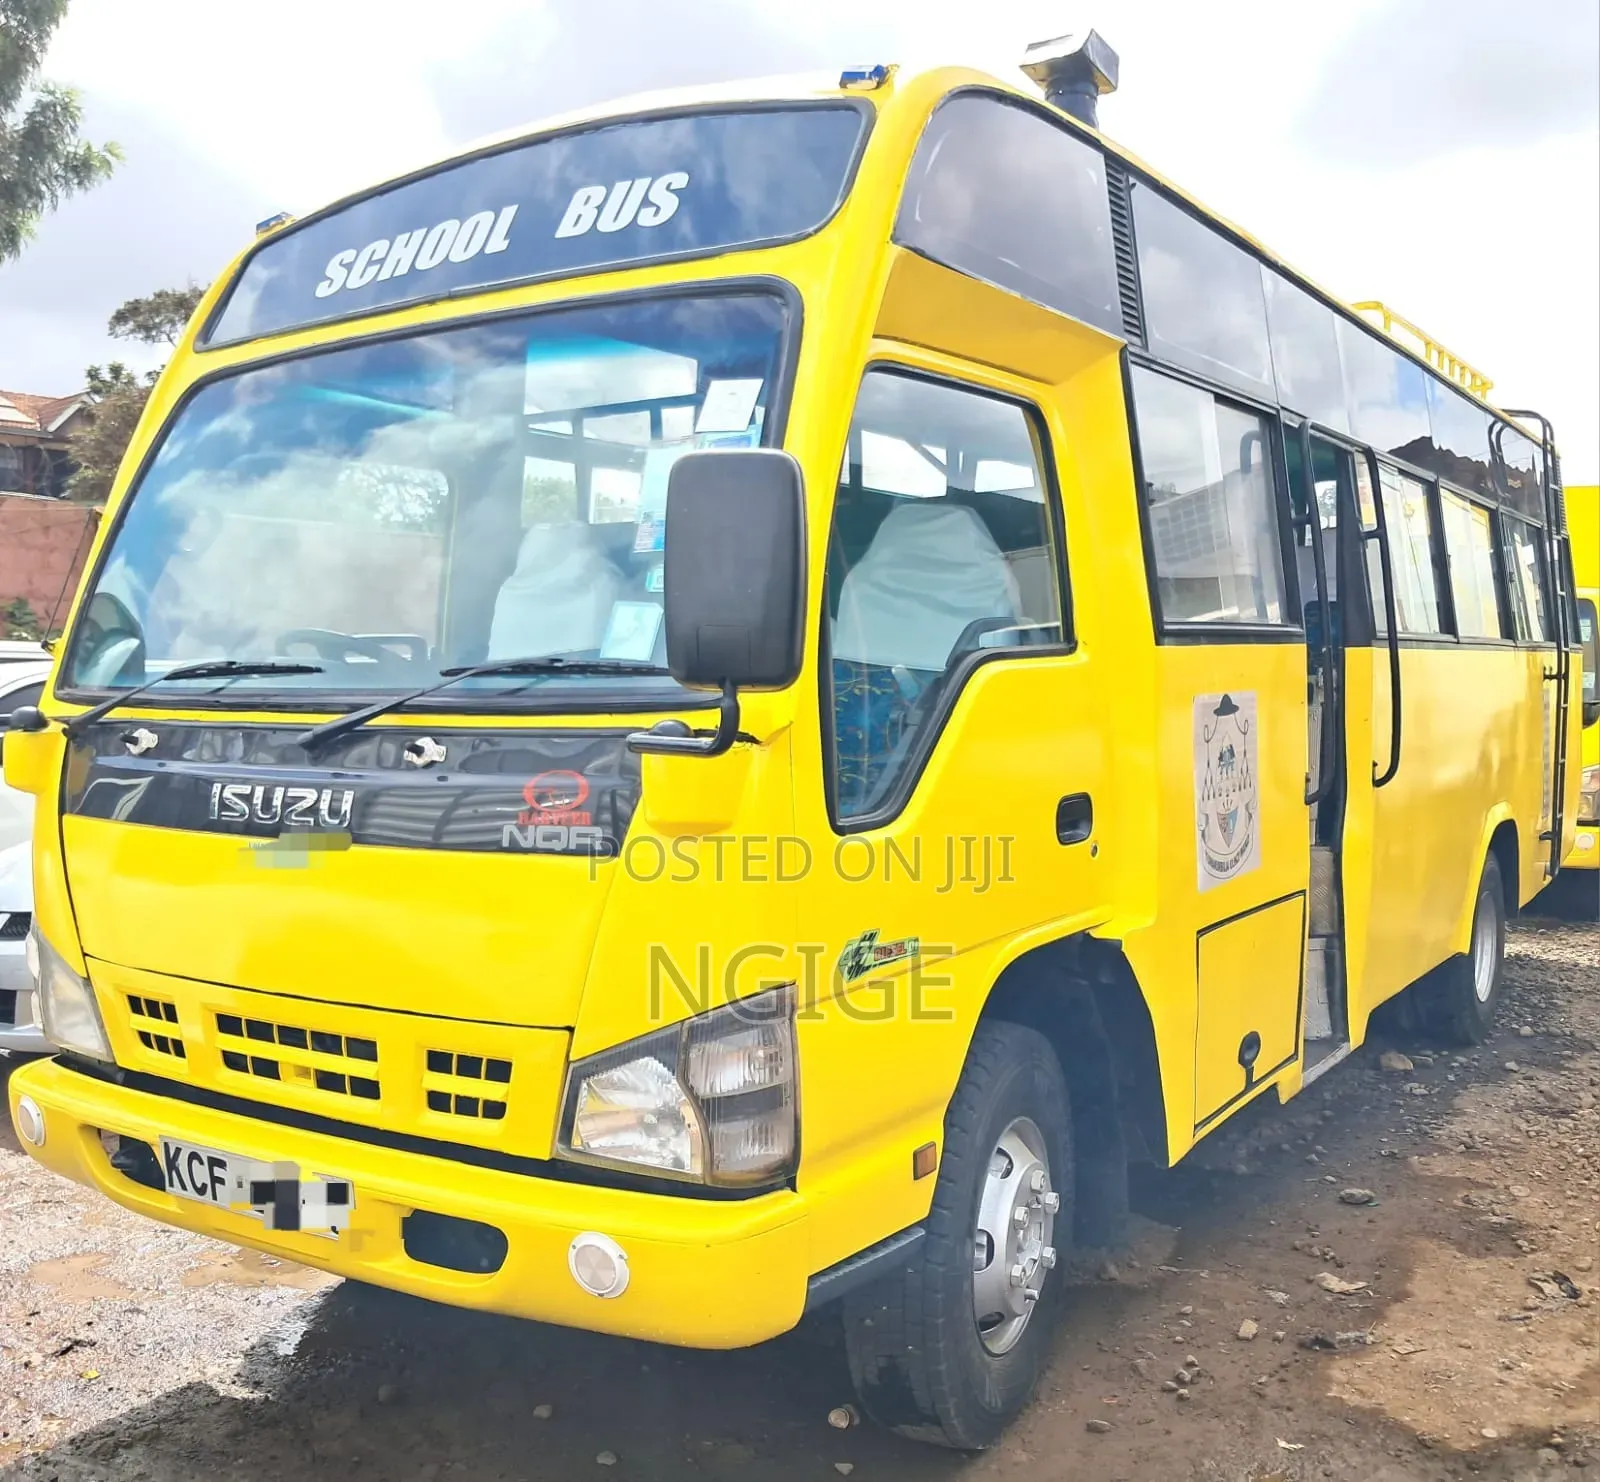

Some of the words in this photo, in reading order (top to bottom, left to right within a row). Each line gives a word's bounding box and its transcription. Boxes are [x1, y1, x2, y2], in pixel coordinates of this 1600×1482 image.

[315, 204, 519, 298] SCHOOL
[555, 172, 690, 239] BUS
[209, 782, 356, 828] ISUZU
[502, 825, 603, 850] NQR
[164, 1141, 228, 1201] KCF
